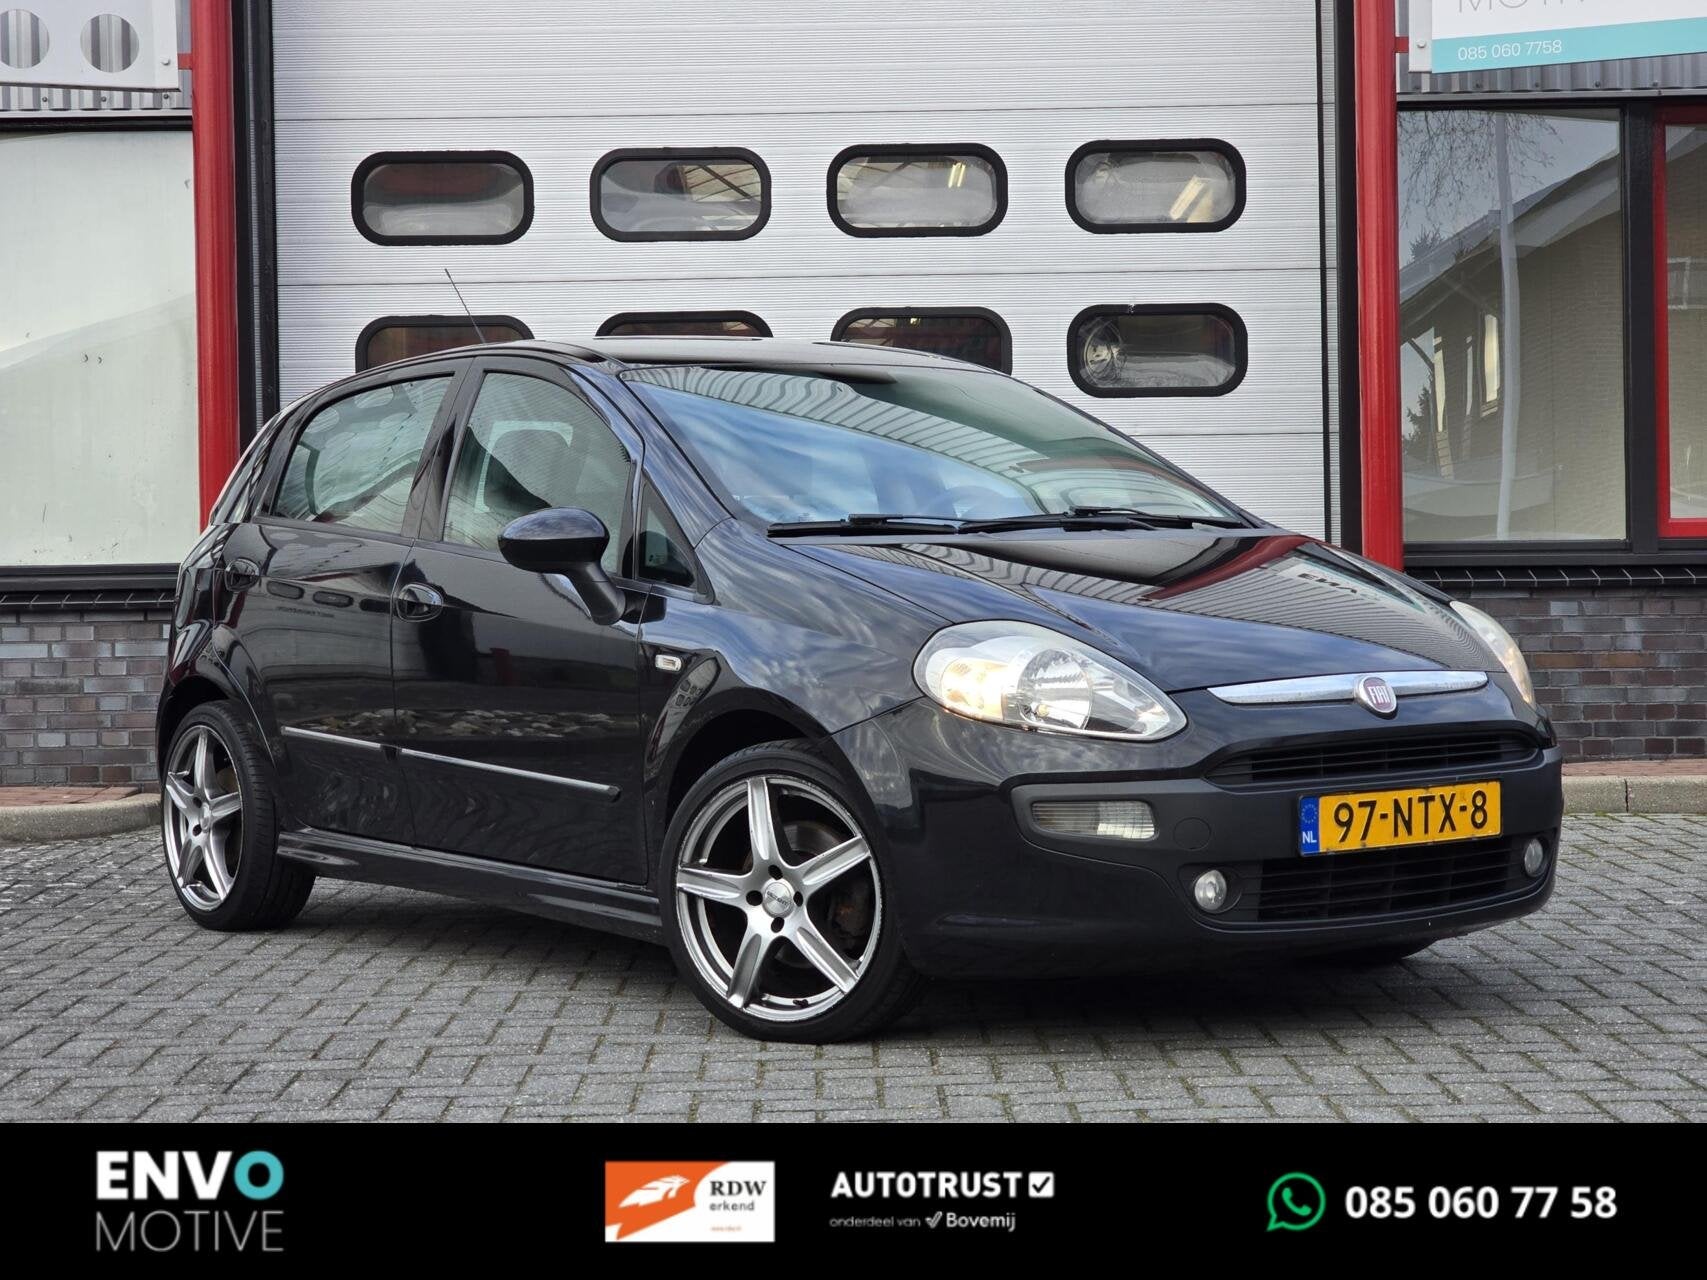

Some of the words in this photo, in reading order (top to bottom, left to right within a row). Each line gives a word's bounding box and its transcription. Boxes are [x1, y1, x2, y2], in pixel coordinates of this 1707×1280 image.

[1457, 46, 1487, 61] 085
[1491, 43, 1521, 58] 060
[1525, 40, 1562, 56] 7758
[1367, 685, 1391, 704] FIAT
[1333, 789, 1488, 843] 97-NTX-8
[1302, 831, 1318, 844] NL
